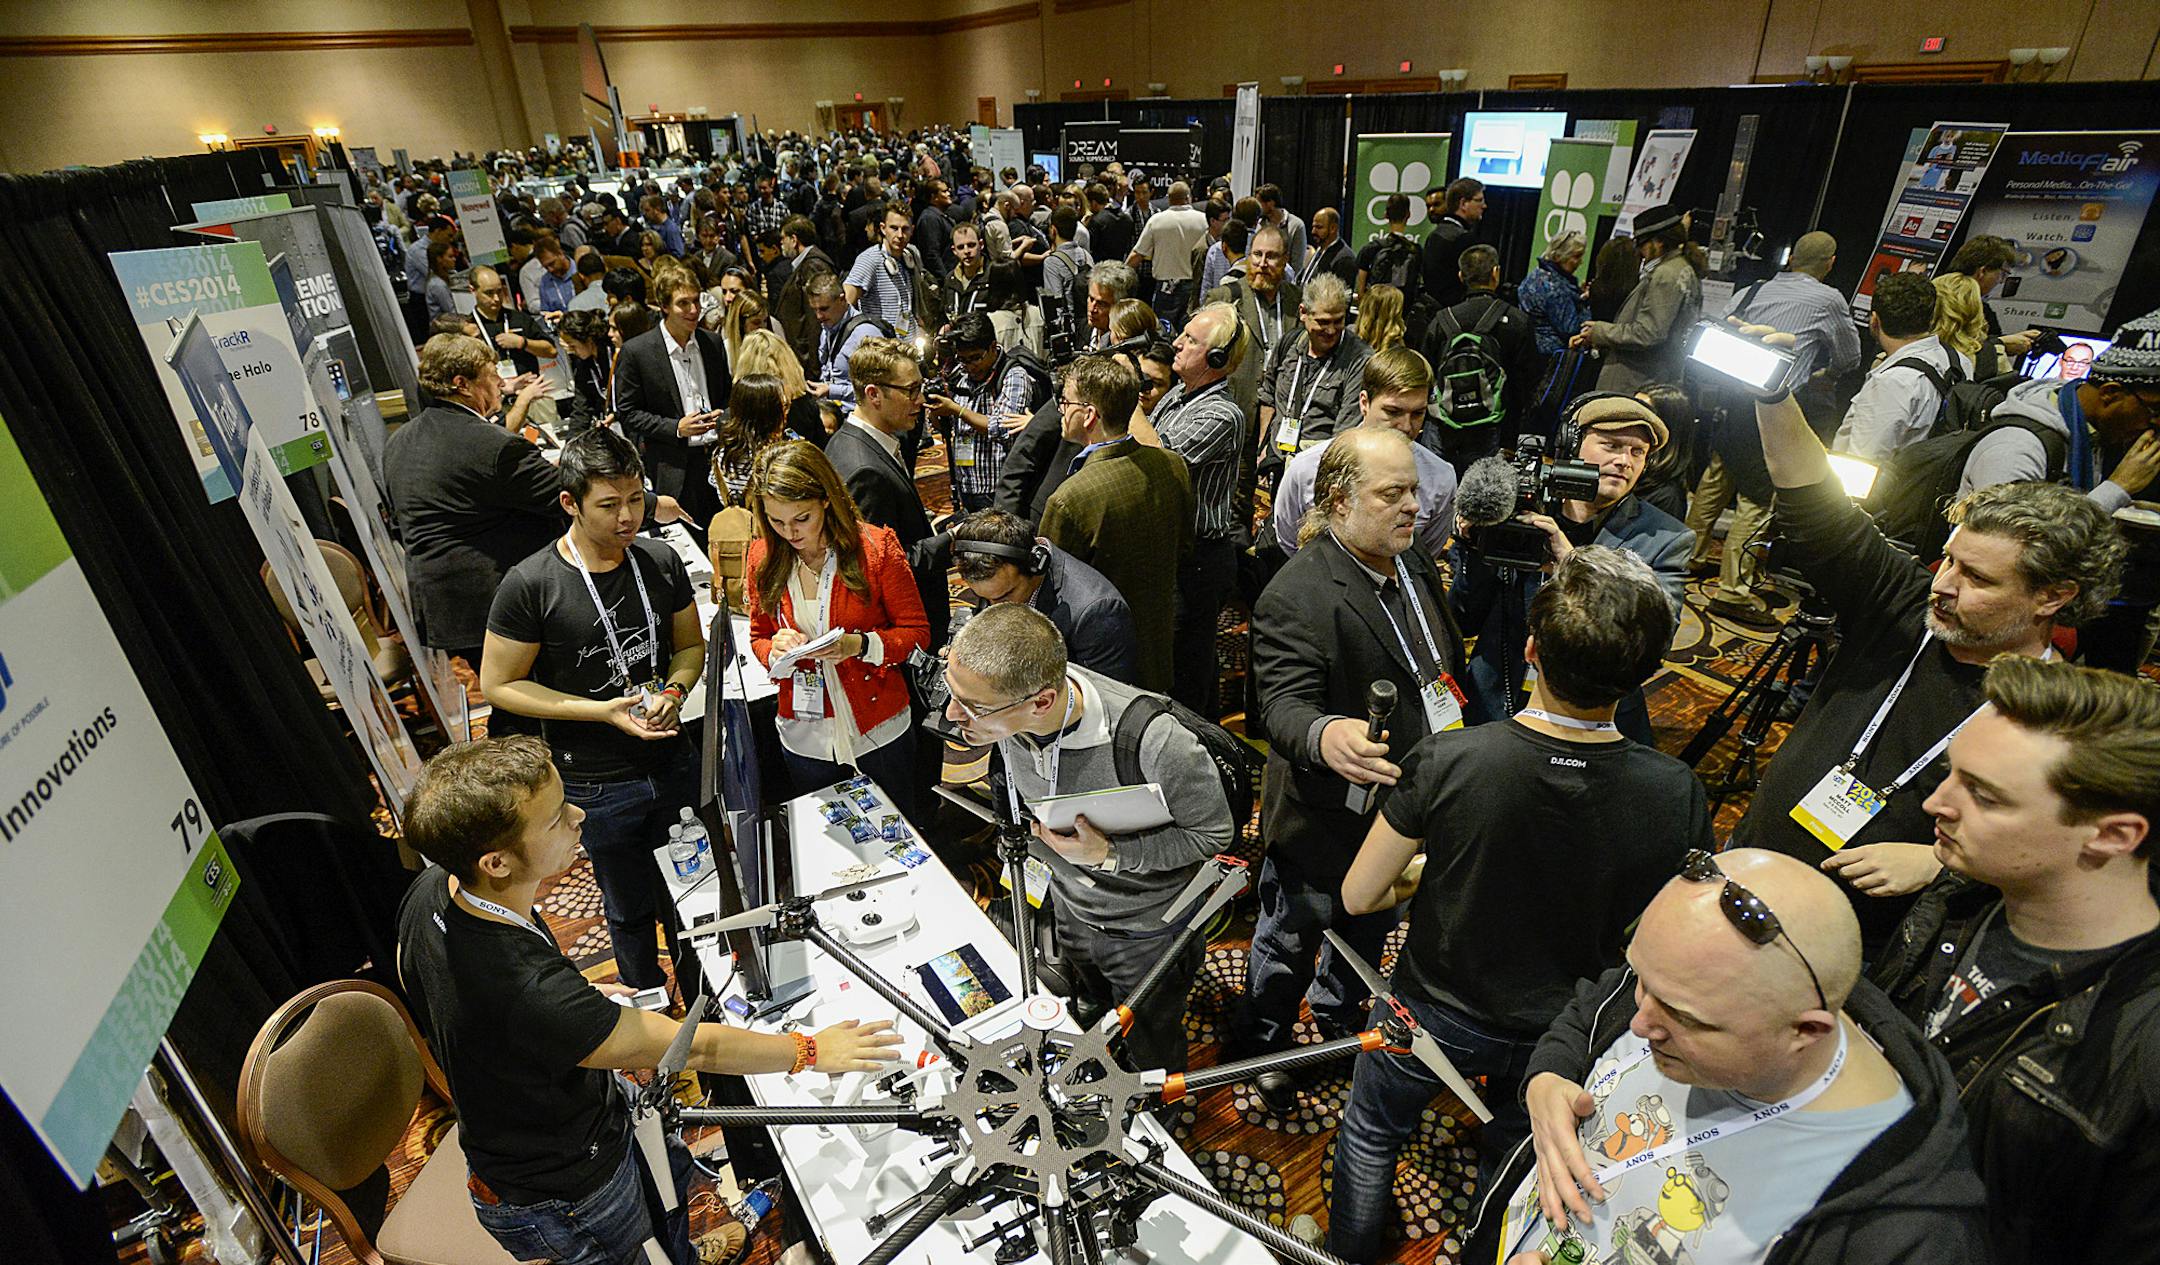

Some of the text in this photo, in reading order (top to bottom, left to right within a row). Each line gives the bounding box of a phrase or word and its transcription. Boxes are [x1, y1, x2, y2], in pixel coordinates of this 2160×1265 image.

[1068, 140, 1118, 156] DREAM
[2006, 180, 2044, 190] Personal
[135, 274, 241, 309] #CES2014
[2003, 306, 2040, 318] Share.
[242, 361, 272, 379] Halo
[299, 412, 320, 431] 78
[1862, 722, 1878, 743] SONY
[1550, 756, 1587, 769] DJI.COM
[1908, 756, 1929, 776] SONY
[0, 705, 118, 843] Innovations
[171, 798, 203, 854] 79
[205, 860, 221, 886] CES
[479, 901, 508, 915] SONY
[1967, 965, 1996, 999] THE
[1823, 1049, 1845, 1085] SONY
[1592, 1069, 1617, 1092] SONY
[1753, 1102, 1790, 1122] SONY
[1685, 1127, 1720, 1146] SONY
[1625, 1151, 1655, 1169] SONY
